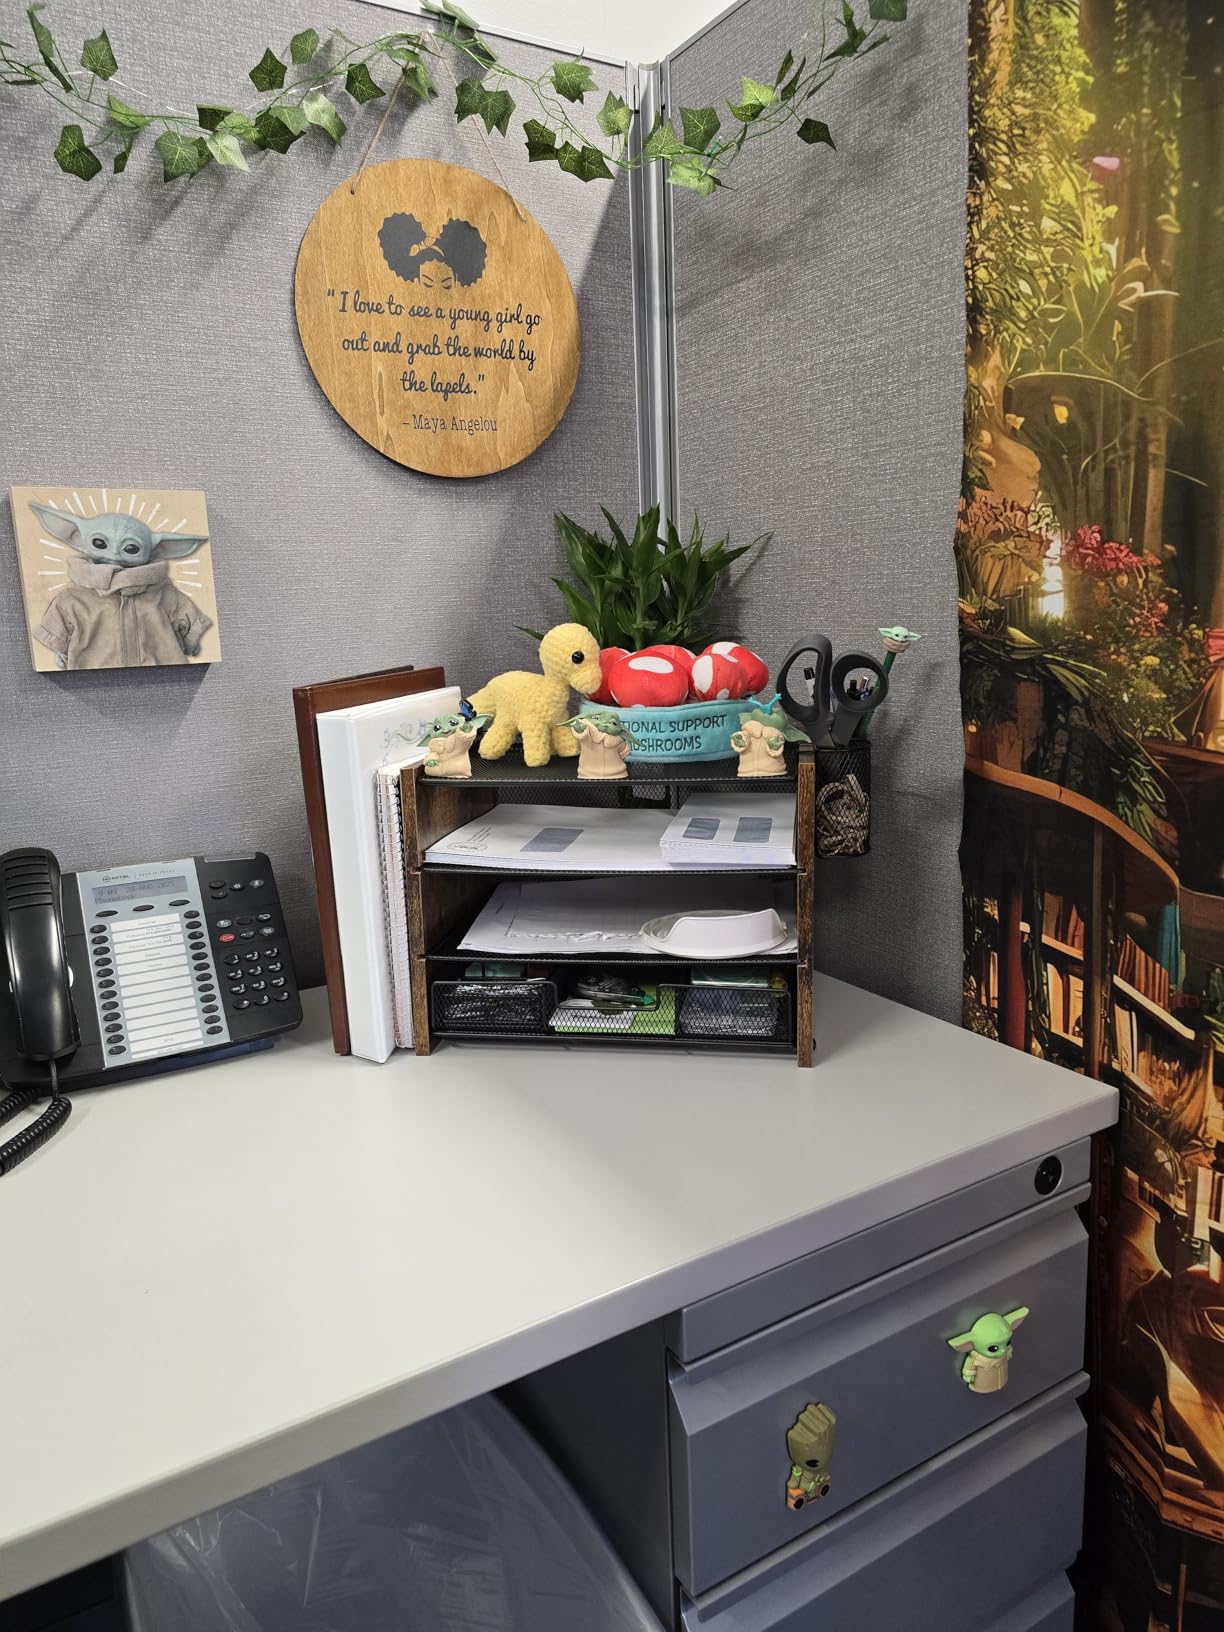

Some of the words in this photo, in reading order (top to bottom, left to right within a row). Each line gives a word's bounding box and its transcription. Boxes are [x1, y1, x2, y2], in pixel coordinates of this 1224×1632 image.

[353, 289, 385, 314] love
[386, 294, 405, 316] to
[408, 305, 432, 317] see
[436, 307, 446, 319] a
[449, 307, 492, 332] young
[496, 303, 523, 333] girl
[526, 314, 543, 335] go
[342, 330, 369, 351] out
[373, 331, 402, 353] and
[407, 334, 442, 365] grab
[444, 335, 471, 357] the
[474, 338, 515, 360] world
[519, 339, 537, 371] by
[400, 370, 428, 392] the
[431, 371, 485, 401] lapels."
[450, 416, 497, 435] Angelou
[669, 714, 727, 733] SUPPORT
[631, 735, 702, 753] USHROOMS
